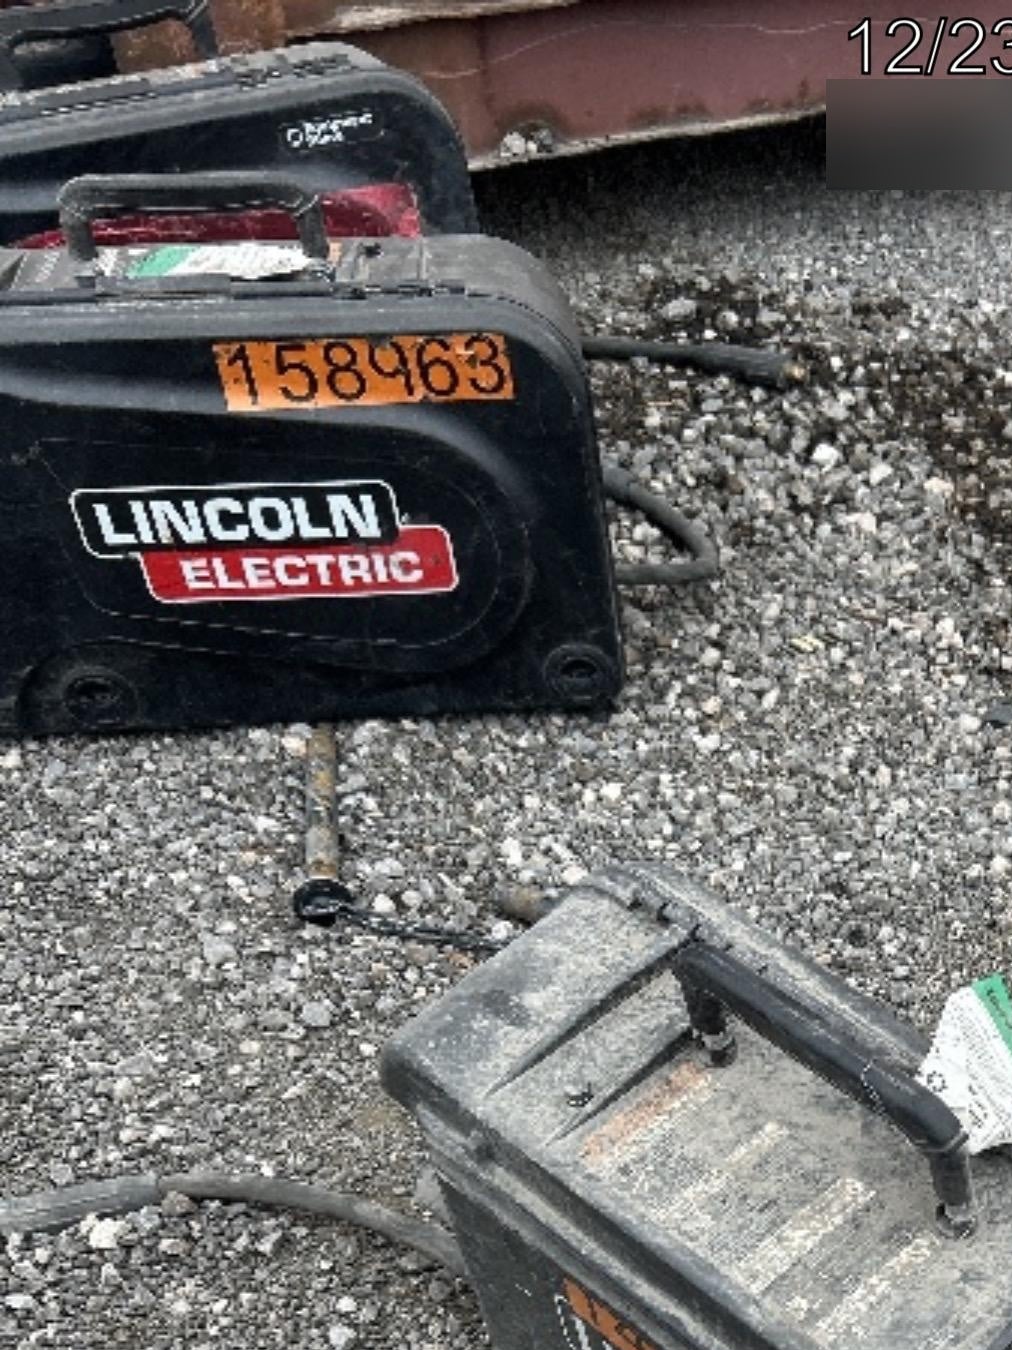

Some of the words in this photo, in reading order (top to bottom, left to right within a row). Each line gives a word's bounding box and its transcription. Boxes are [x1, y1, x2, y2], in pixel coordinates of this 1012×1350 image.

[226, 333, 505, 406] 158963
[93, 493, 382, 546] LINCOLN
[179, 550, 425, 590] ELECTRIC
